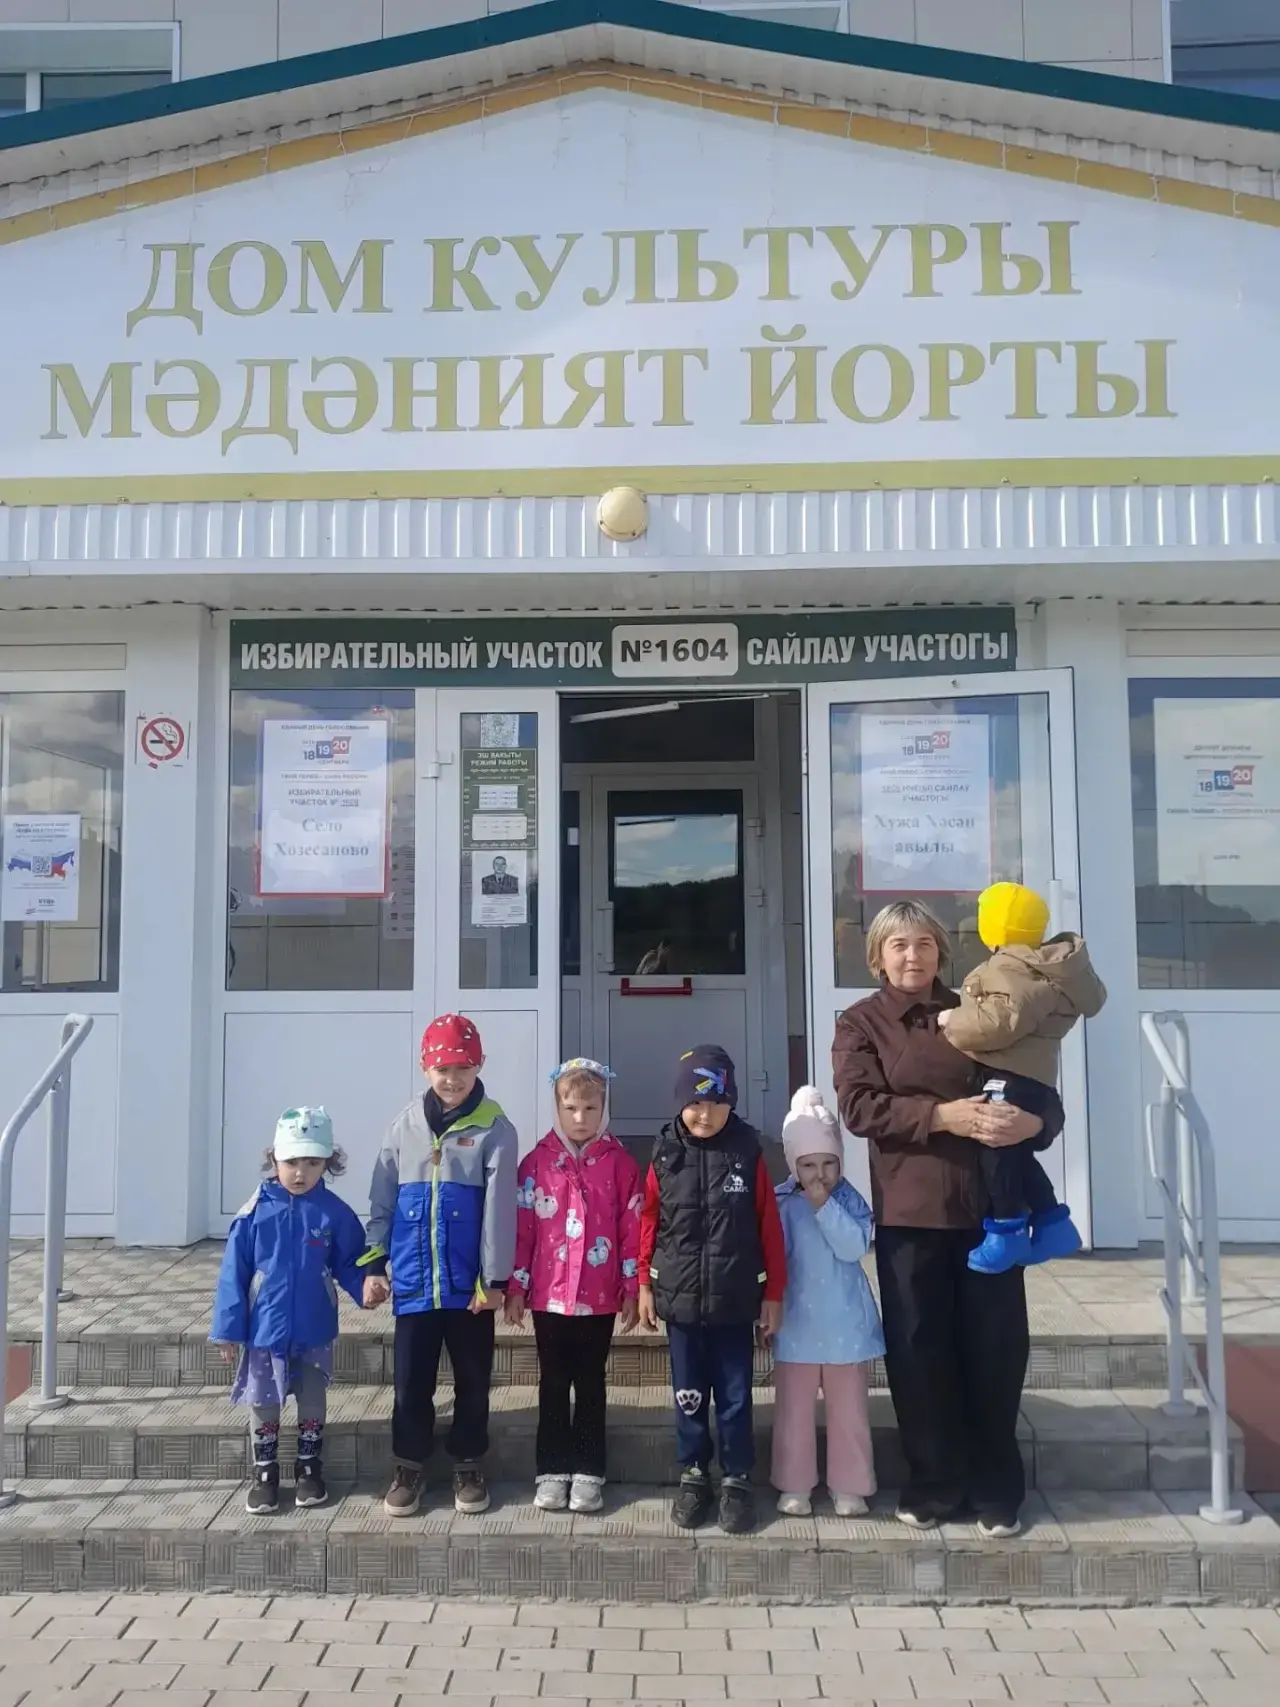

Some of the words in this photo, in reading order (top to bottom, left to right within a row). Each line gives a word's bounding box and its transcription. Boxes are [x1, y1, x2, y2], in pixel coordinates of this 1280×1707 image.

[126, 239, 394, 337] ДОМ
[423, 220, 1082, 312] КУЛЬТУРЫ
[40, 348, 708, 456] МӘДӘНИЯТ
[740, 323, 1178, 424] ЙОРТЫ
[241, 636, 477, 670] ИЗБИРАТЕЛЬНЫЙ
[487, 641, 603, 670] УЧАСТОК
[620, 638, 729, 663] №1604
[746, 632, 856, 665] САЙЛАУ
[863, 632, 1009, 664] УЧАСТОГЫ
[303, 750, 316, 761] 18
[318, 744, 331, 756] 19
[332, 740, 349, 751] 20
[902, 746, 915, 756] 18
[917, 739, 931, 750] 19
[932, 734, 948, 746] 20
[288, 788, 361, 796] ИЗБИРАТЕЛЬНЫЙ
[1199, 781, 1213, 793] 18
[1216, 775, 1230, 787] 19
[1233, 769, 1251, 781] 20
[290, 798, 328, 806] УЧАСТОК
[301, 817, 343, 832] Село
[274, 842, 370, 857] Хозесаново
